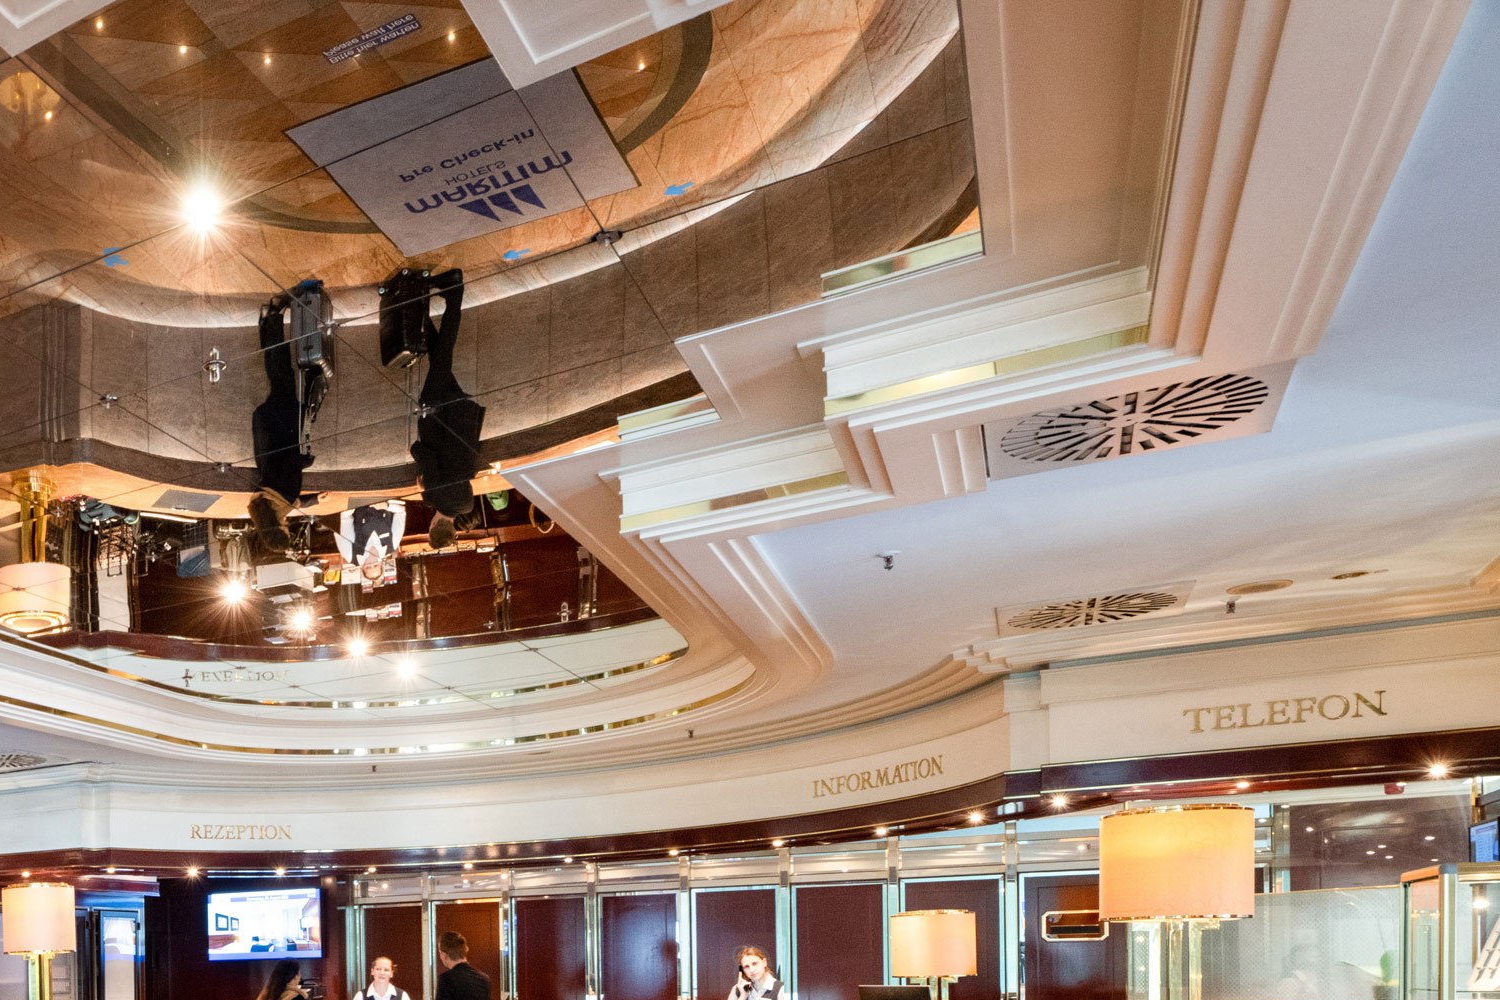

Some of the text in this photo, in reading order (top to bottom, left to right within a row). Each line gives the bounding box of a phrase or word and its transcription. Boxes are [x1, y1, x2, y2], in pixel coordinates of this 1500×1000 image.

[1182, 690, 1388, 734] TELEFON
[812, 755, 944, 798] INFORMATION
[190, 824, 292, 840] REZEPTION
